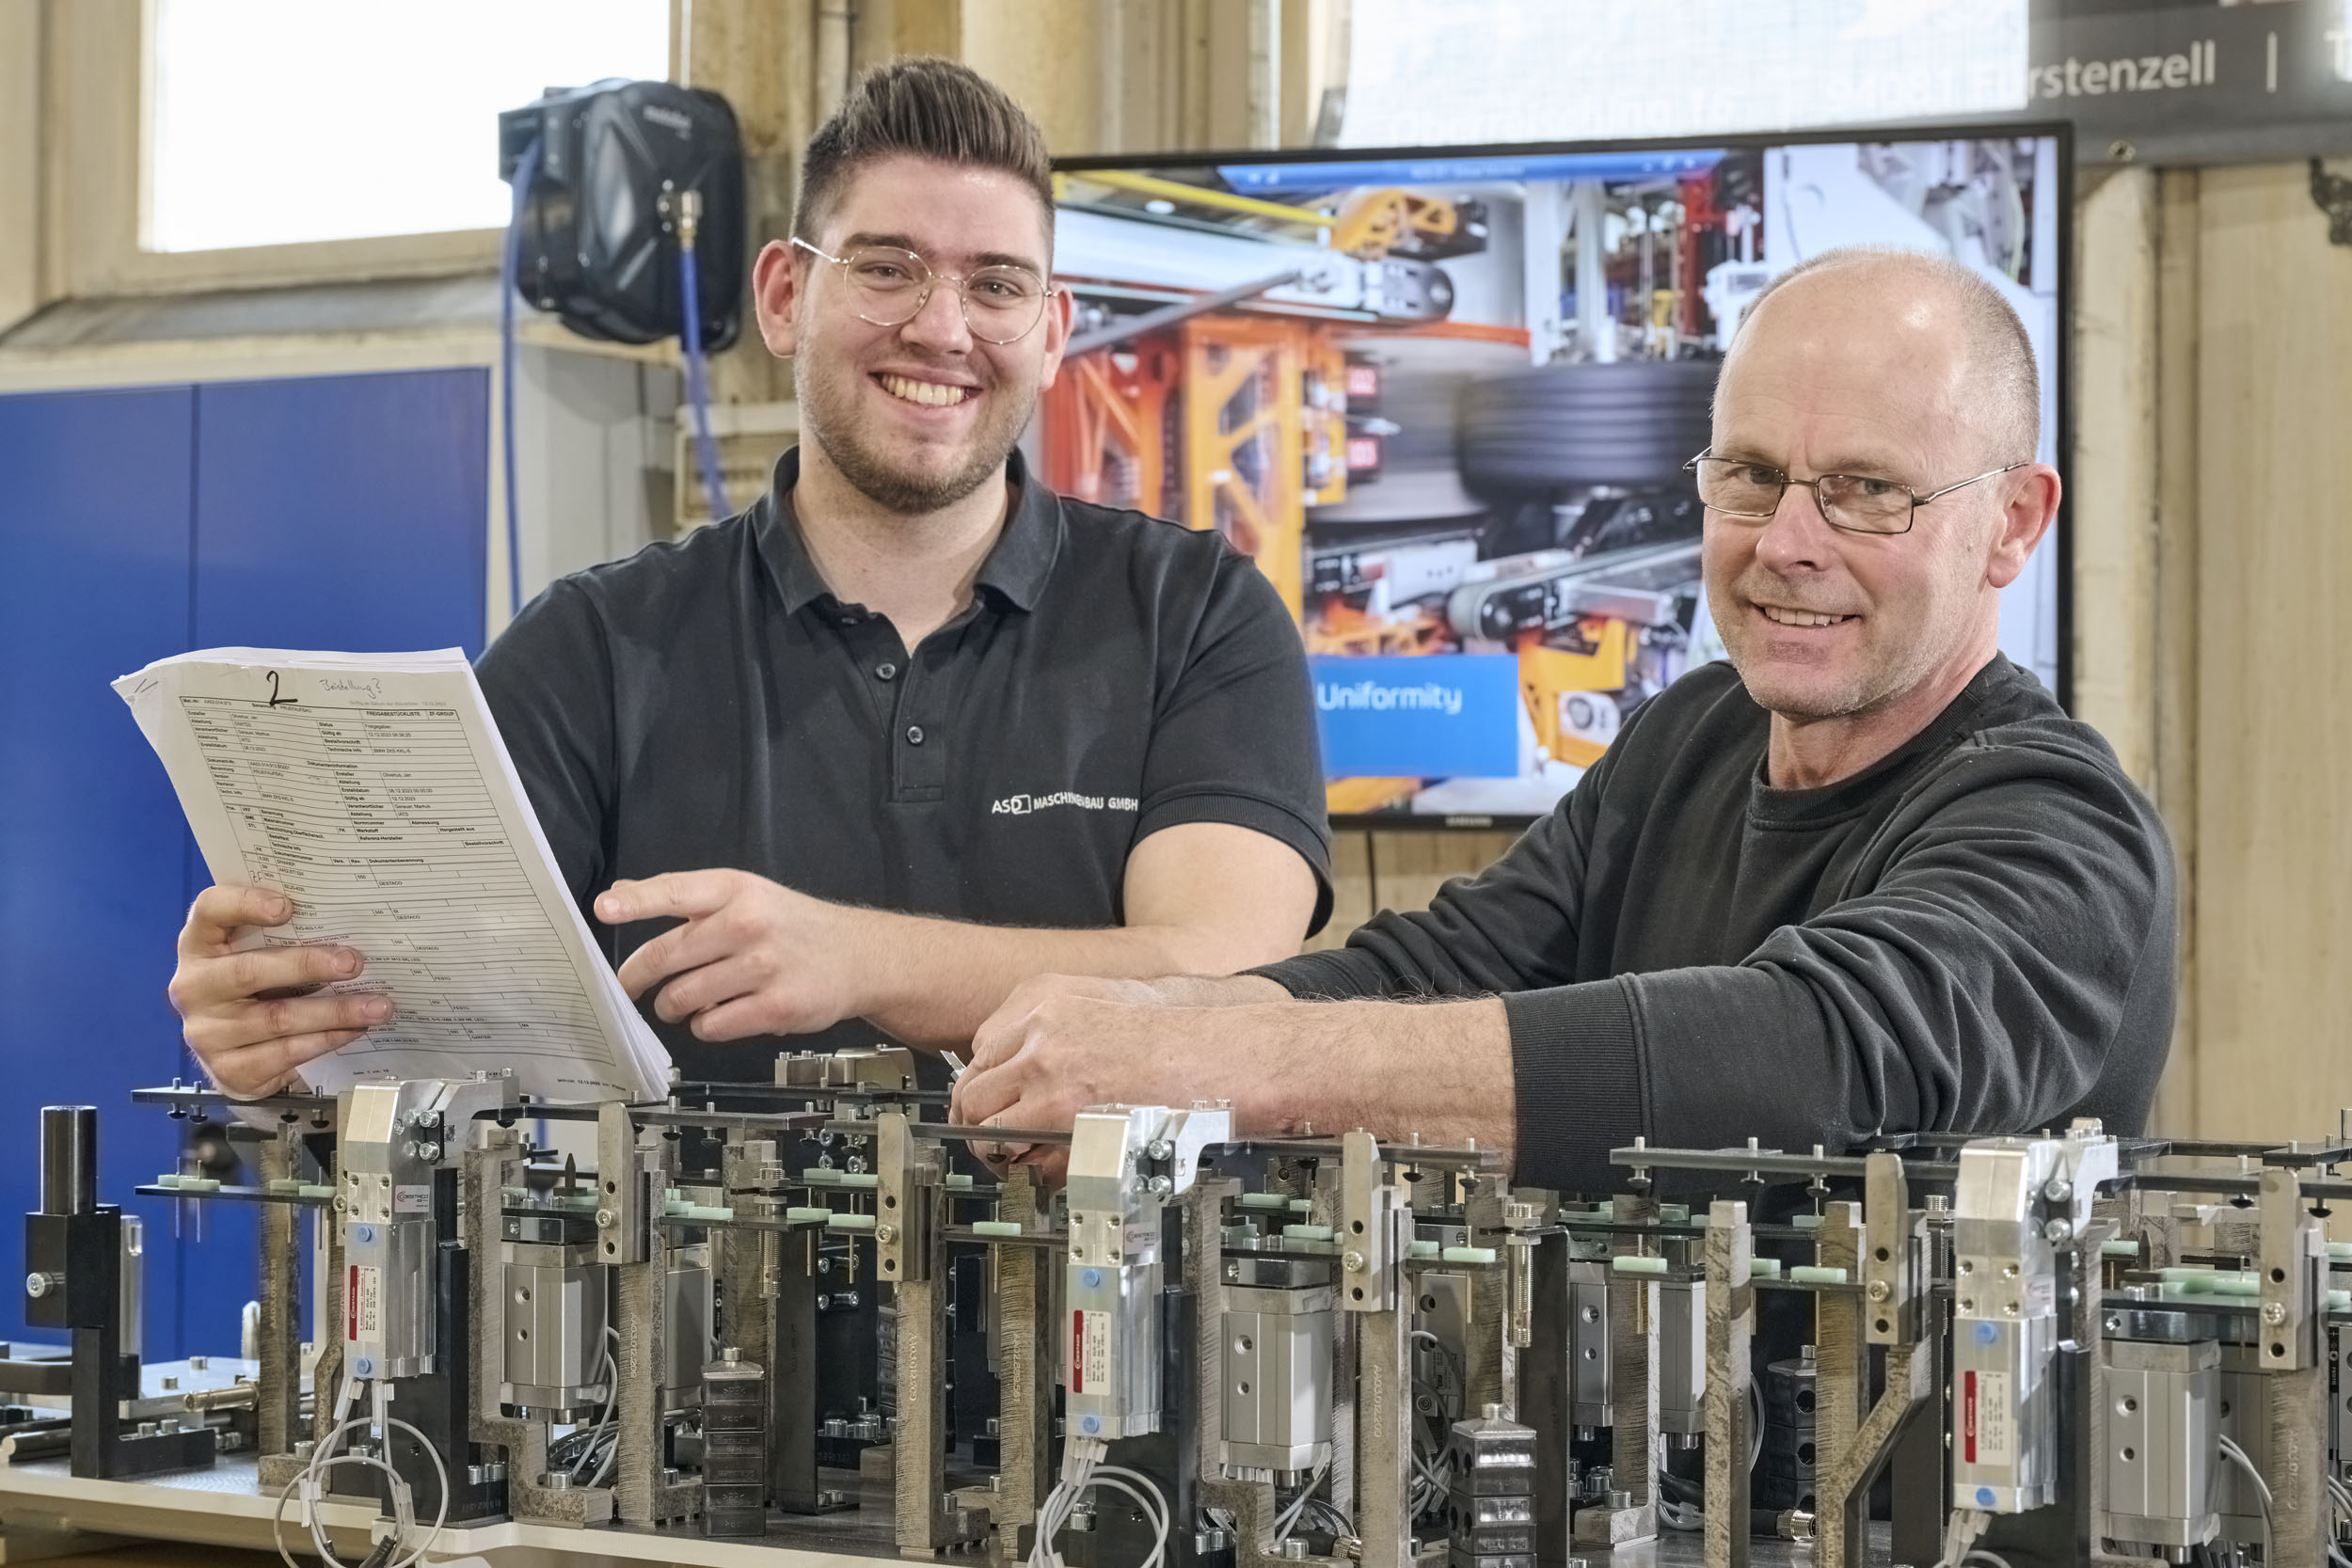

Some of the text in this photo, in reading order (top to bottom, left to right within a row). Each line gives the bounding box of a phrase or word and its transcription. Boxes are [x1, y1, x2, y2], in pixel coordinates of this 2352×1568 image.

[266, 670, 298, 707] 2
[1316, 681, 1463, 715] Uniformity
[1033, 791, 1104, 811] MASCHINENBAU
[1107, 797, 1138, 812] GMBH
